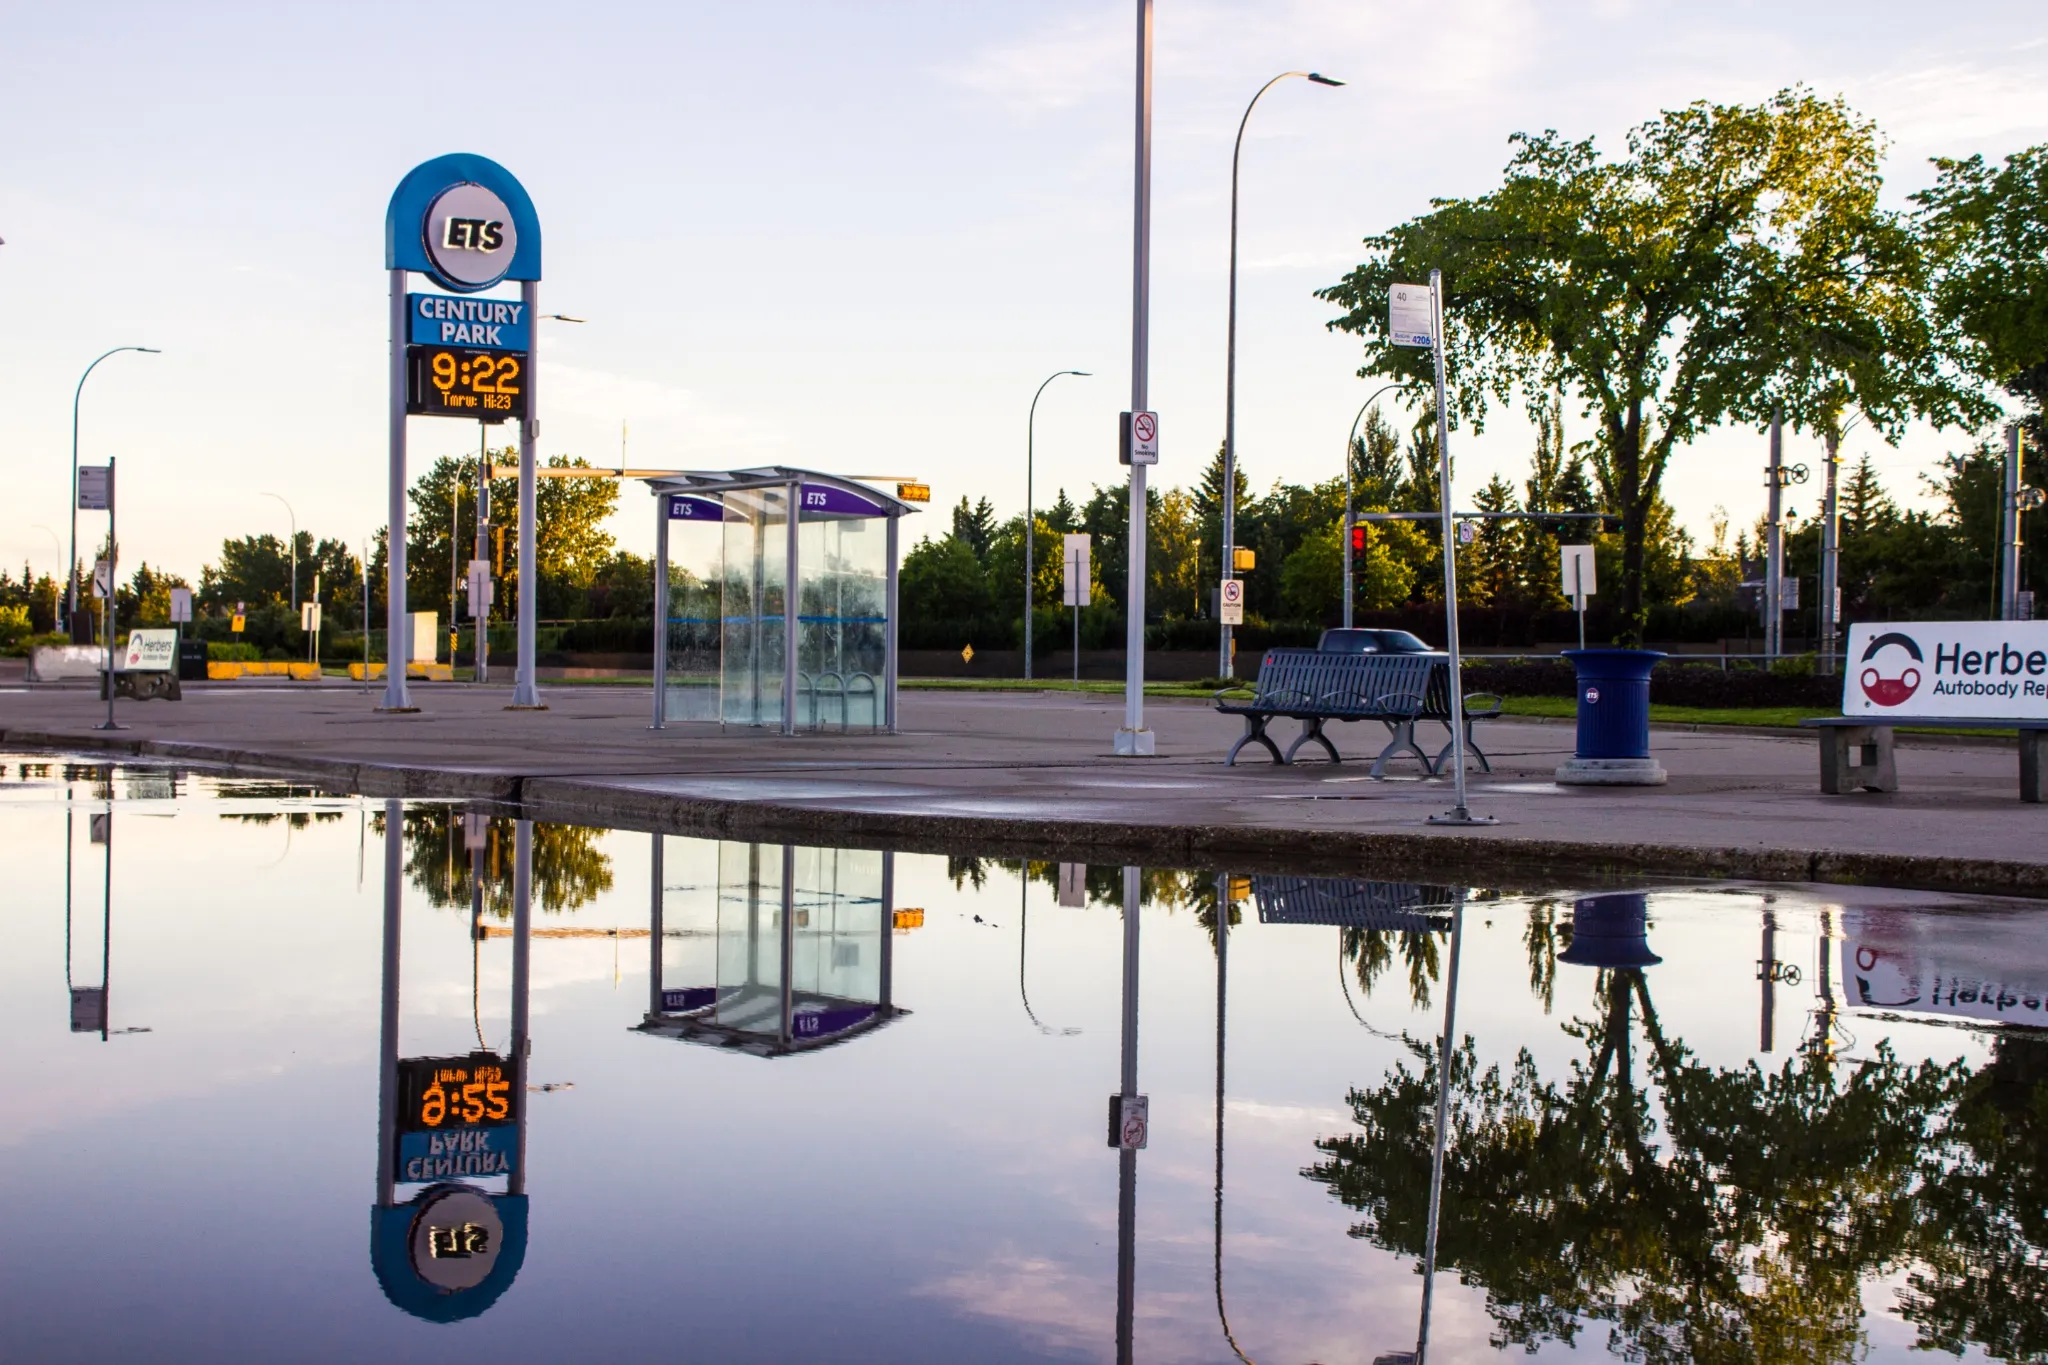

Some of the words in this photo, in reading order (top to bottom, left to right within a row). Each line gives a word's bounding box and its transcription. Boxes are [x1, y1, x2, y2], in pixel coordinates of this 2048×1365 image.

[443, 217, 504, 253] ETS
[1397, 292, 1407, 302] 40
[419, 297, 523, 325] CENTURY
[441, 322, 502, 346] PARK
[1412, 335, 1431, 345] 4206
[432, 352, 520, 394] 9:22
[441, 391, 478, 407] Tmrw:
[484, 393, 511, 410] Hi:23
[1134, 450, 1155, 458] Smoking
[807, 492, 827, 506] ETS
[673, 503, 692, 515] ETS
[144, 637, 172, 652] Herbers
[1934, 642, 2047, 676] Herbe
[1933, 680, 2019, 699] Autobody
